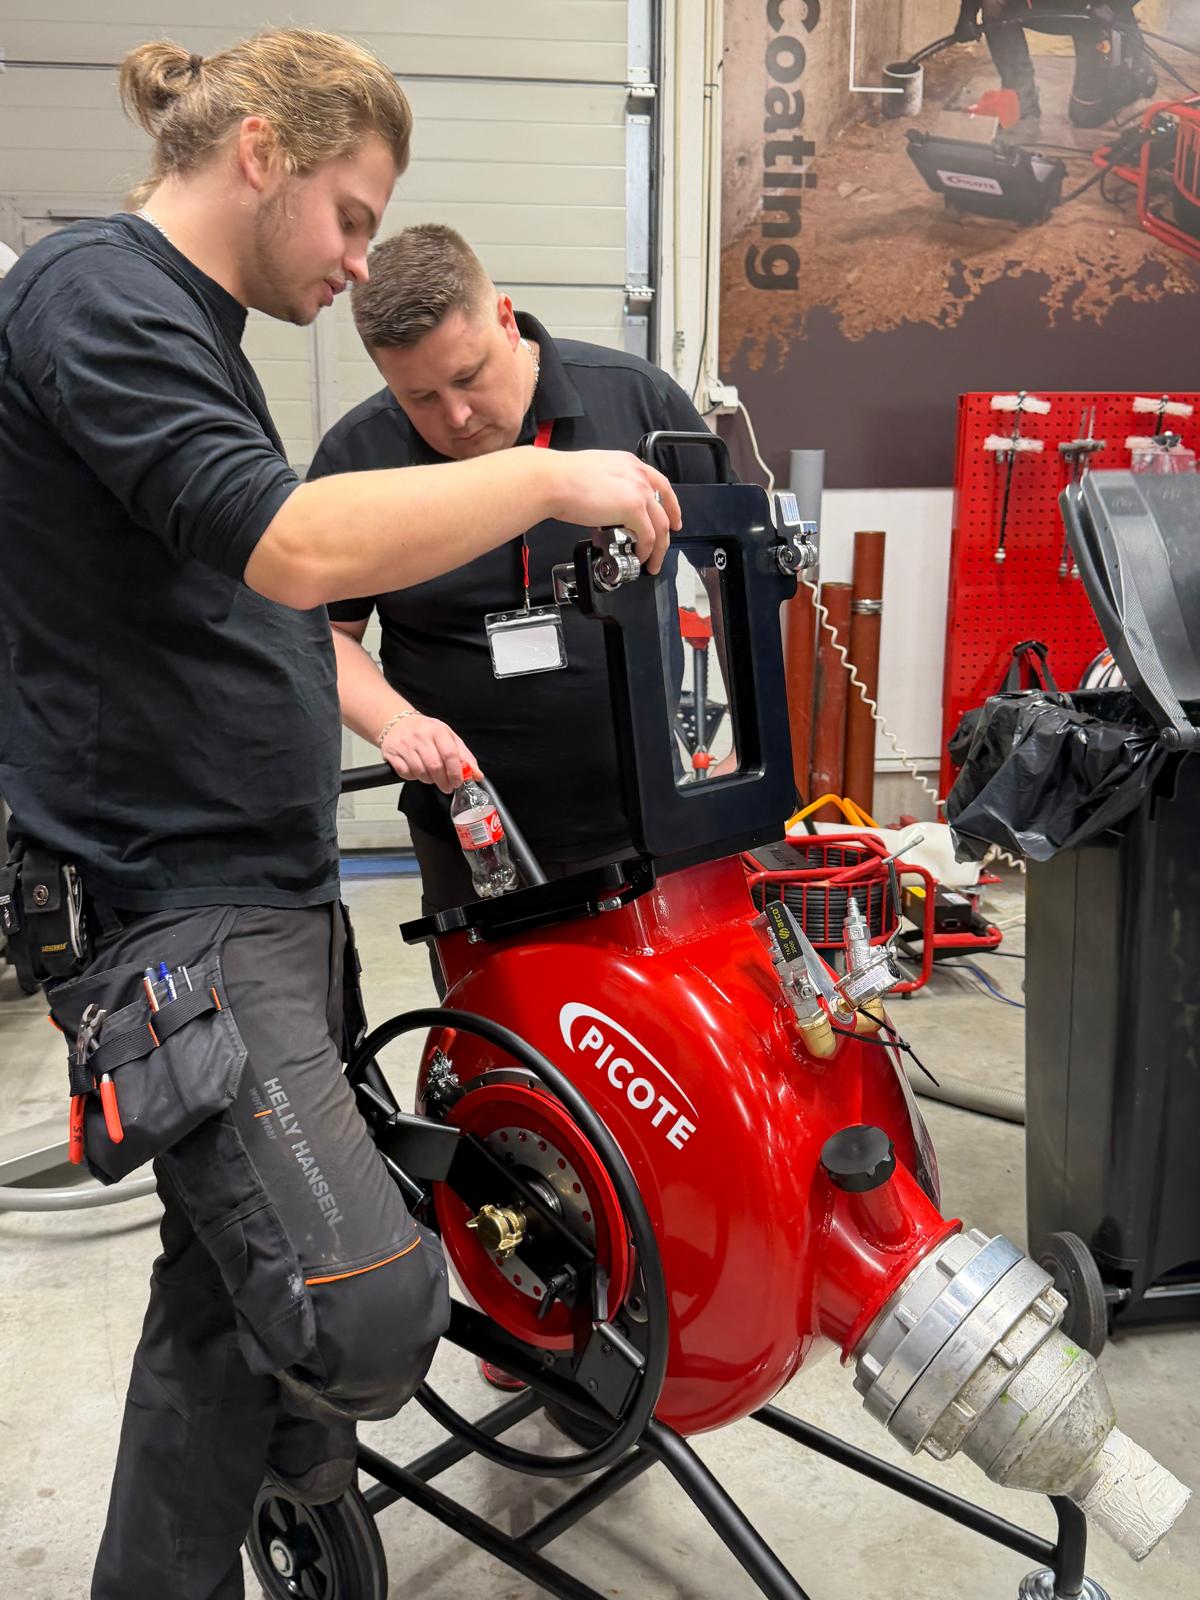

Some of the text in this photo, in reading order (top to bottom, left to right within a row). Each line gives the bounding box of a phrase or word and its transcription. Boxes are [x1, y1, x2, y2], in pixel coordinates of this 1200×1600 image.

[746, 0, 819, 290] Coating
[263, 1077, 344, 1227] HELLY HANSEN
[578, 1025, 697, 1150] PICOTE
